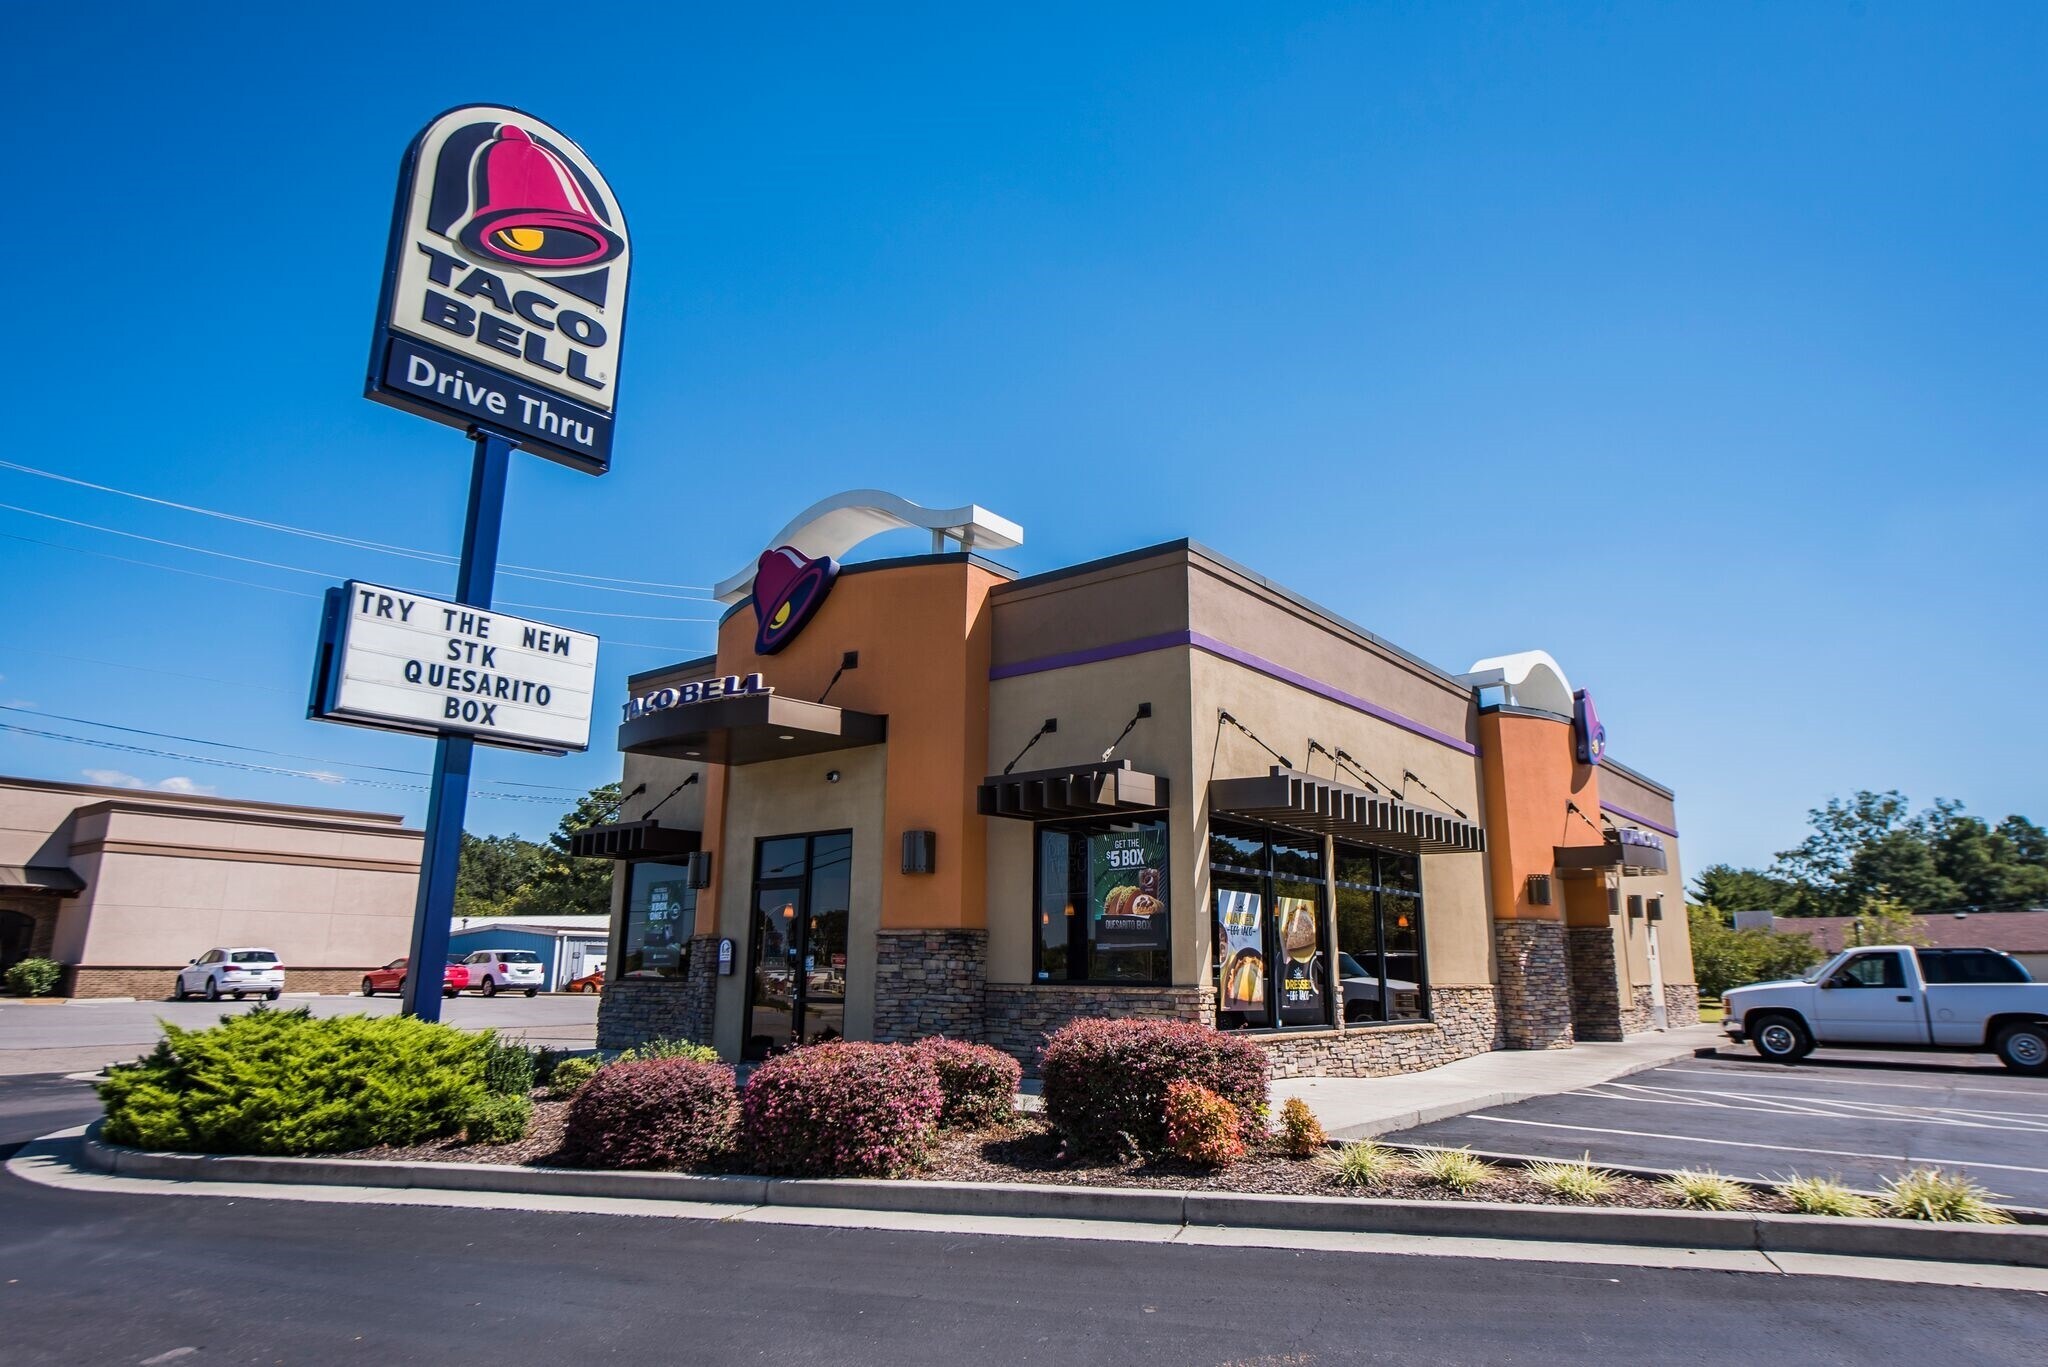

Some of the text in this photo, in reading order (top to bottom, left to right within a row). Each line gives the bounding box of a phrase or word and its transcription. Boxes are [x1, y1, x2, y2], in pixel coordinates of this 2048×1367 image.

[416, 240, 607, 348] TACO
[422, 288, 606, 390] BELL
[406, 354, 595, 447] Drive Thru
[360, 590, 571, 656] TRY THE NEW
[447, 638, 496, 668] STK
[404, 659, 551, 707] QUESARITO
[623, 672, 775, 722] TACO BELL
[444, 695, 497, 726] BOX
[1105, 848, 1145, 867] $5 BOX
[1114, 838, 1141, 849] GET THE
[1105, 919, 1153, 930] QUESARITO BOX
